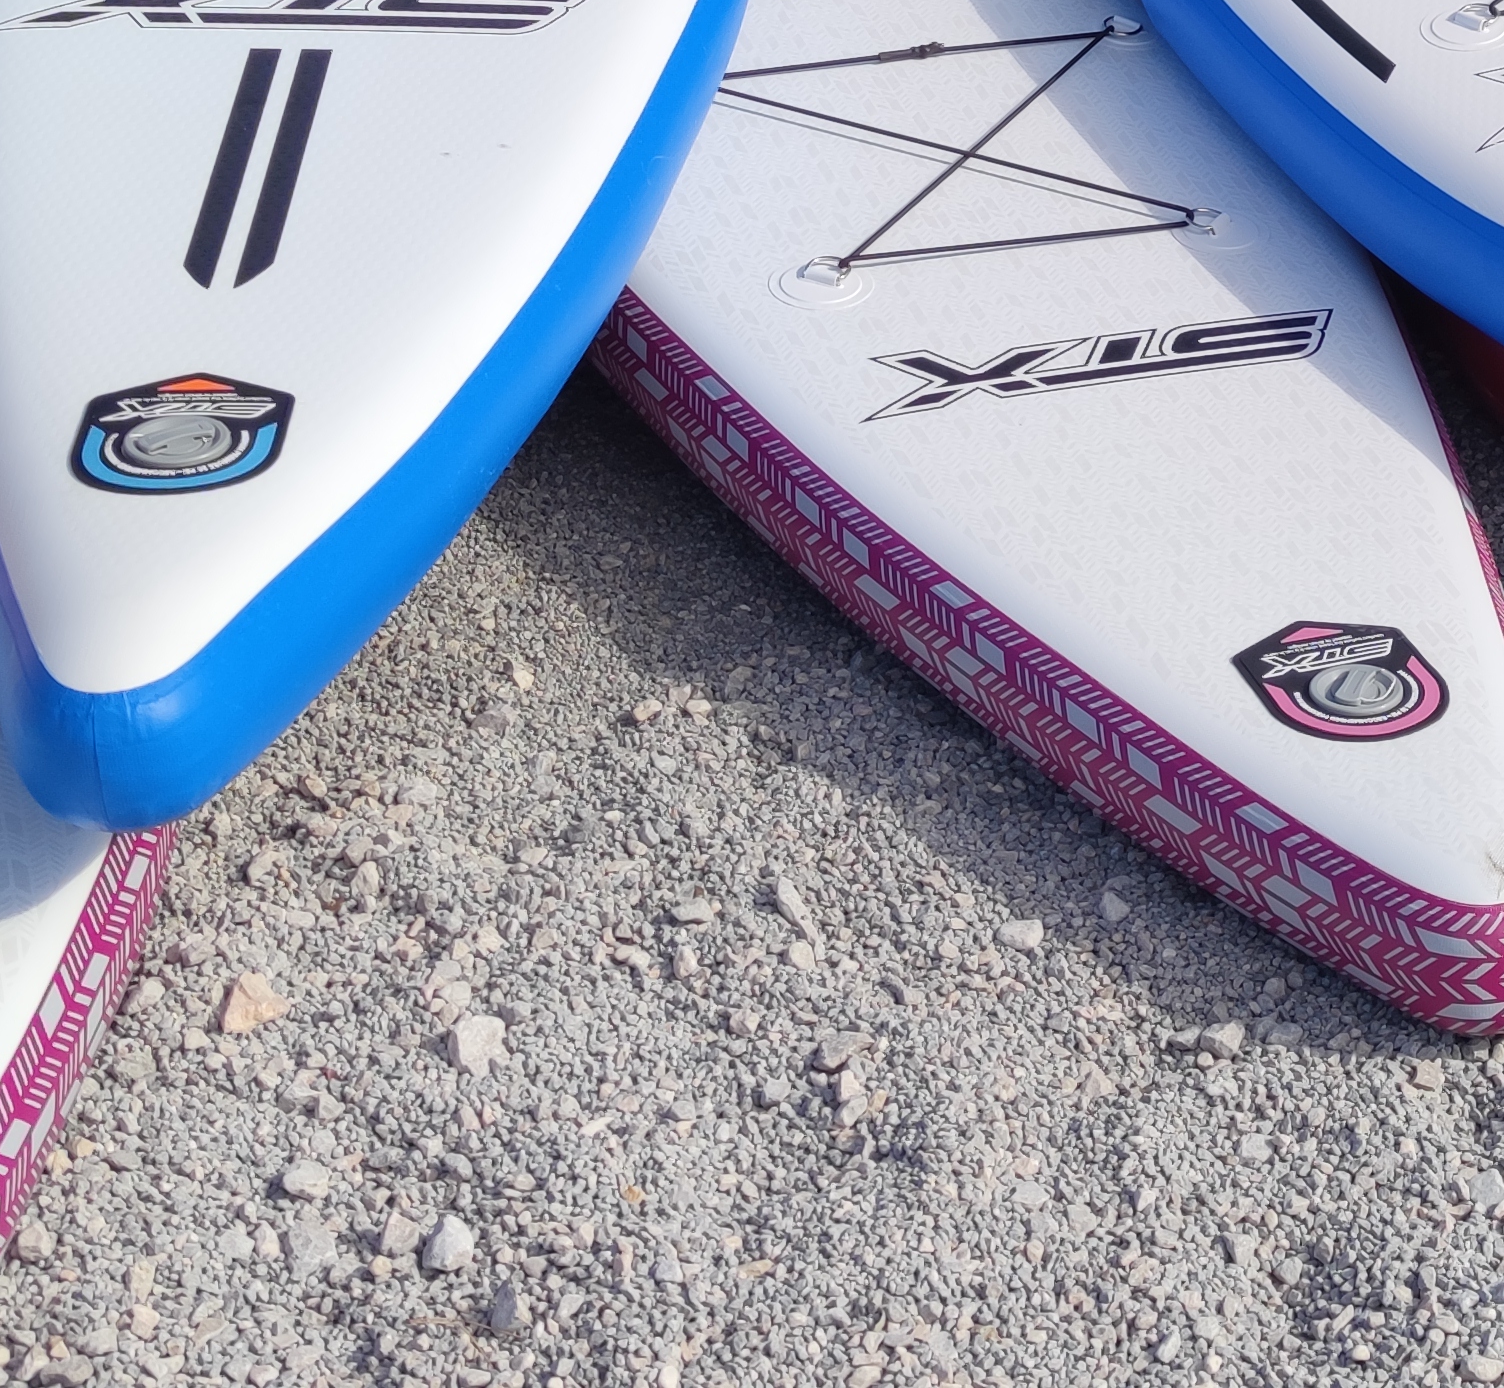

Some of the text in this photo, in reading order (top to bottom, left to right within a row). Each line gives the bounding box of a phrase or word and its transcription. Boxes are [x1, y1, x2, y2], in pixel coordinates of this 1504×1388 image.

[860, 308, 1334, 424] STX
[98, 402, 277, 423] STX
[1260, 637, 1393, 679] STX
